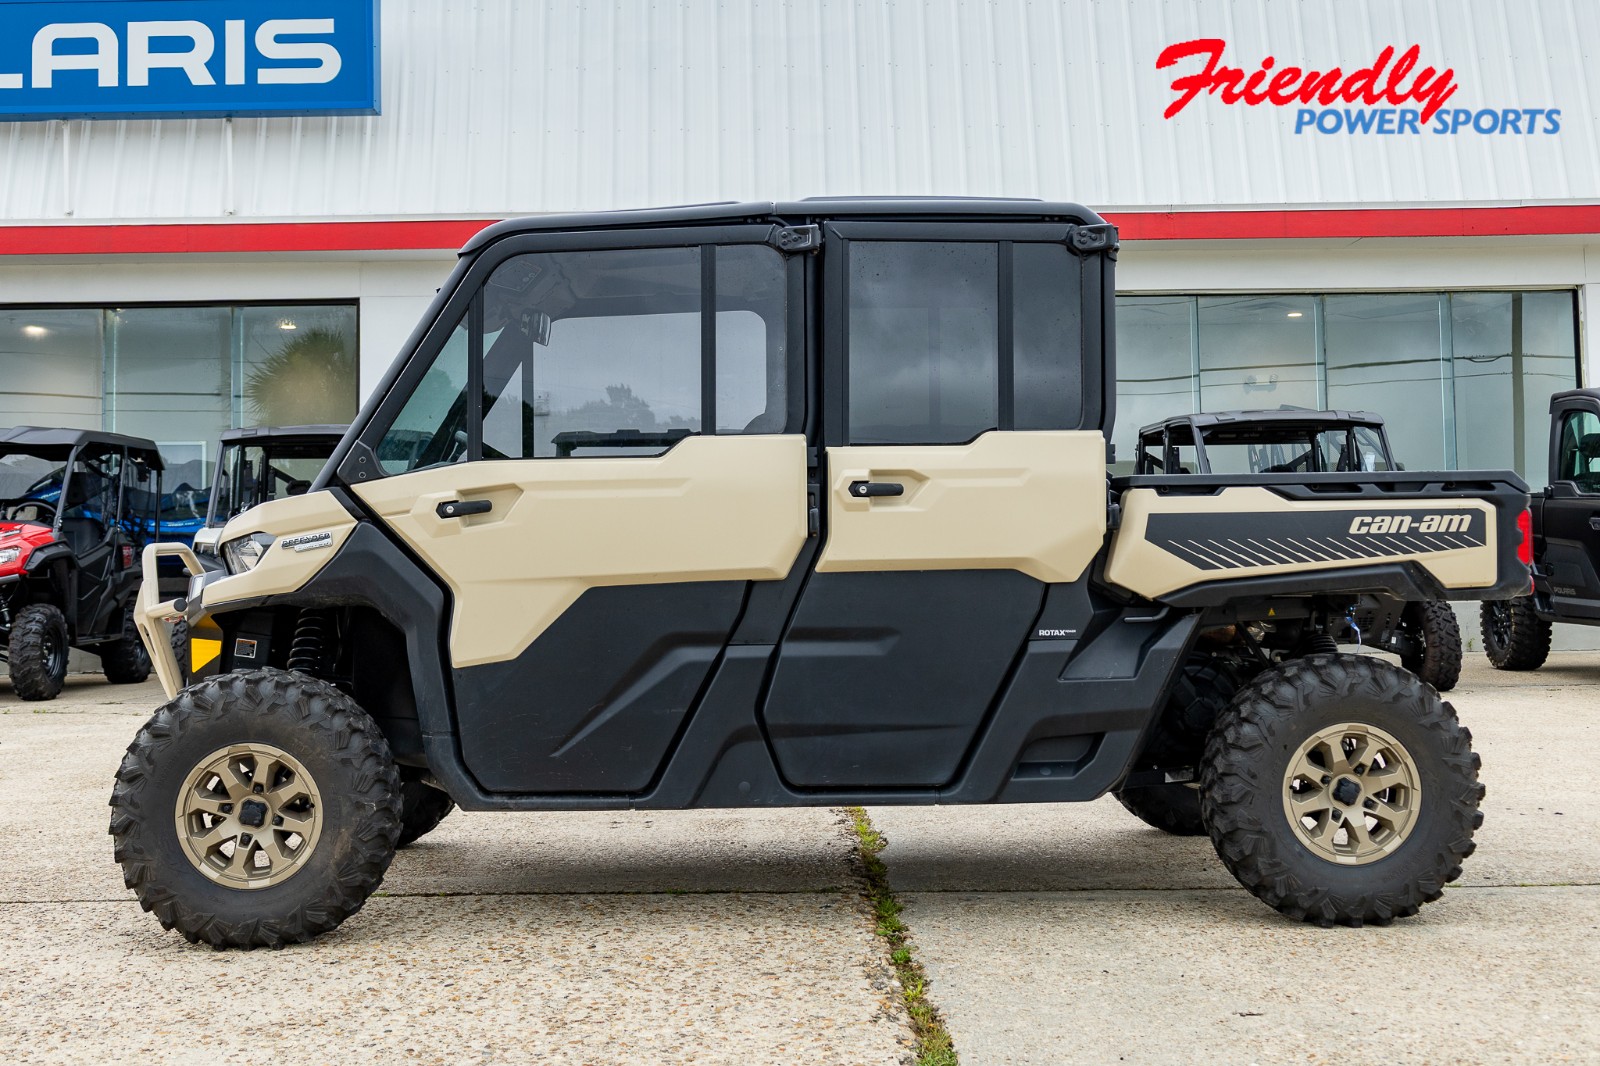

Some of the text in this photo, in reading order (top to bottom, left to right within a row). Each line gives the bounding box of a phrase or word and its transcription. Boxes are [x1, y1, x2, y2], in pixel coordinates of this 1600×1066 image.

[1348, 514, 1472, 534] can-am
[281, 532, 331, 548] DEFENDER
[1038, 629, 1066, 637] ROTAX
